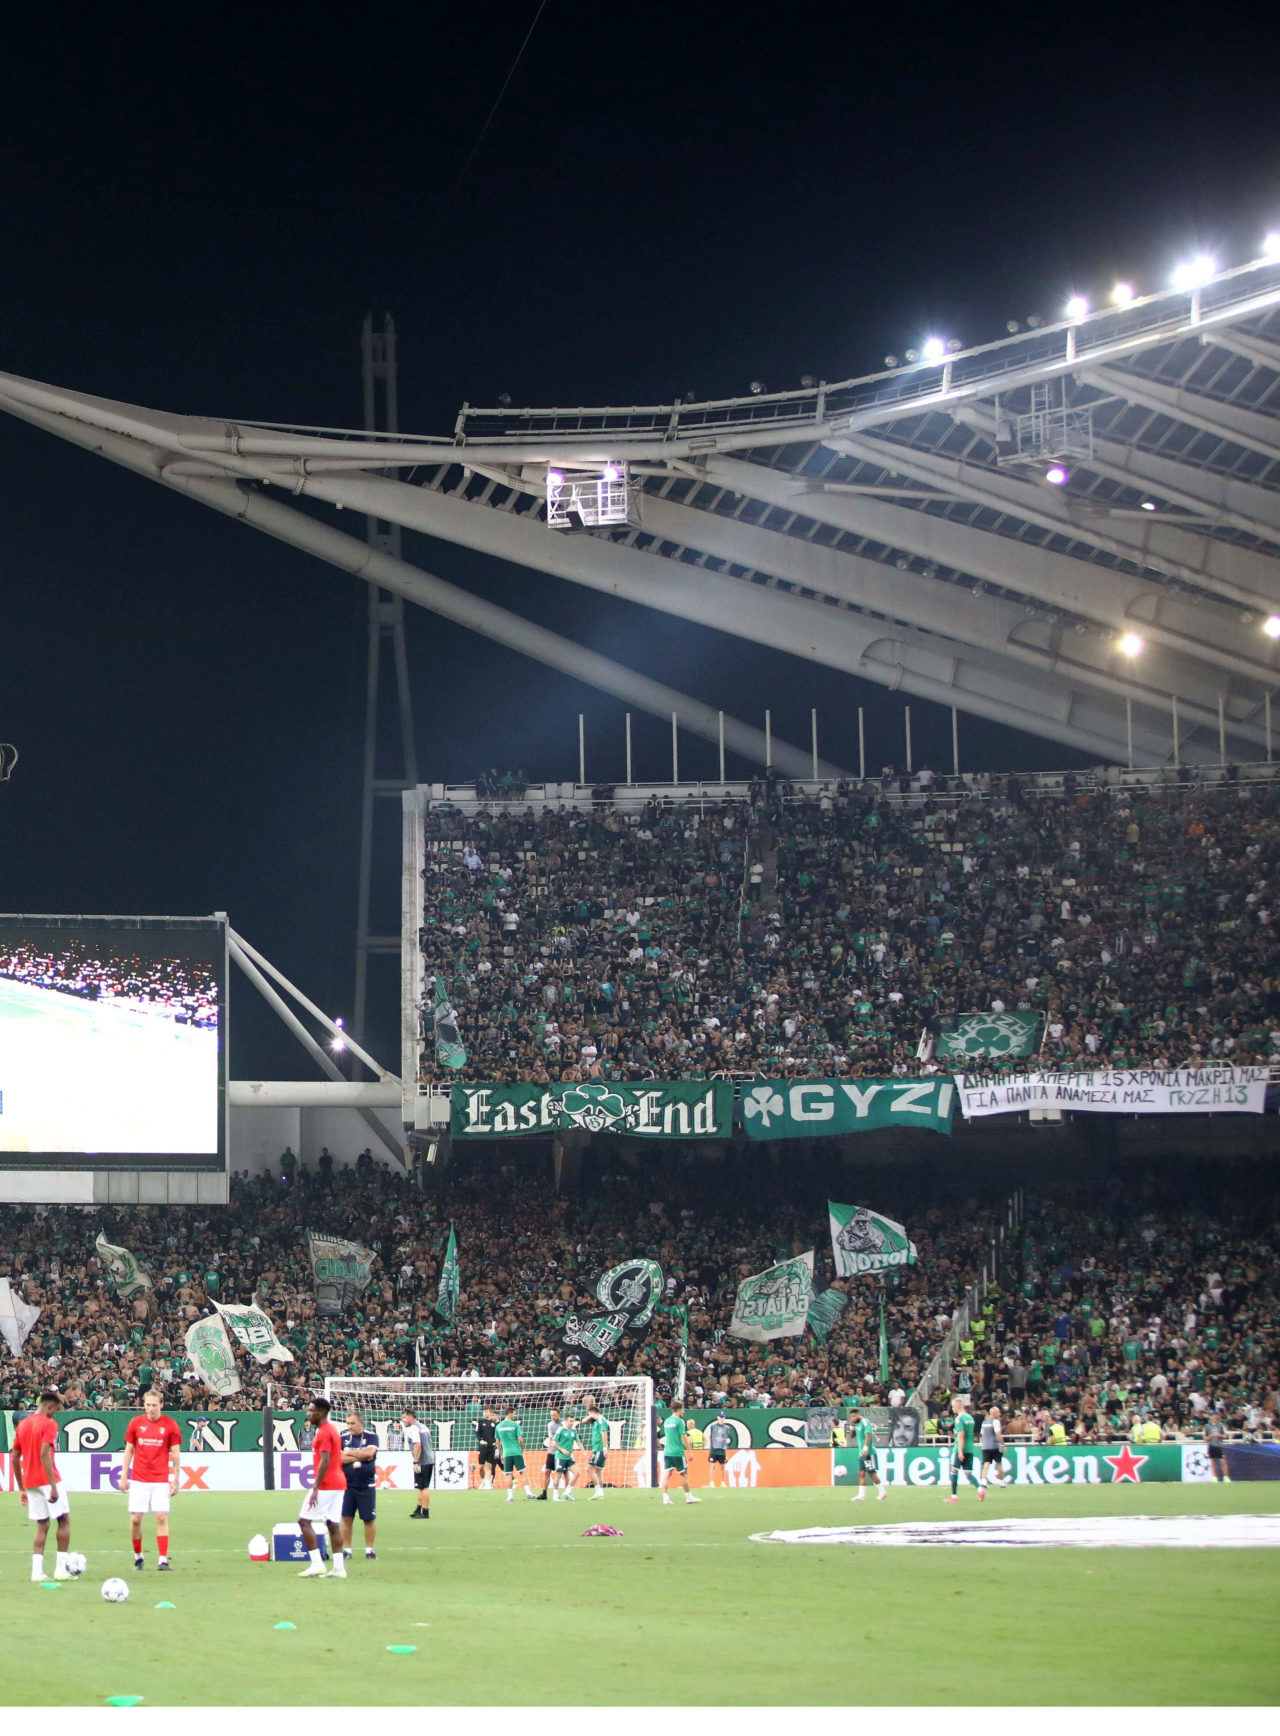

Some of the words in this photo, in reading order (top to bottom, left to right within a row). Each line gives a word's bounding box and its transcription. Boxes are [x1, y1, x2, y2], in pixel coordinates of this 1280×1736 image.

[461, 1089, 556, 1132] East
[630, 1090, 718, 1134] End
[789, 1081, 953, 1121] GYZI
